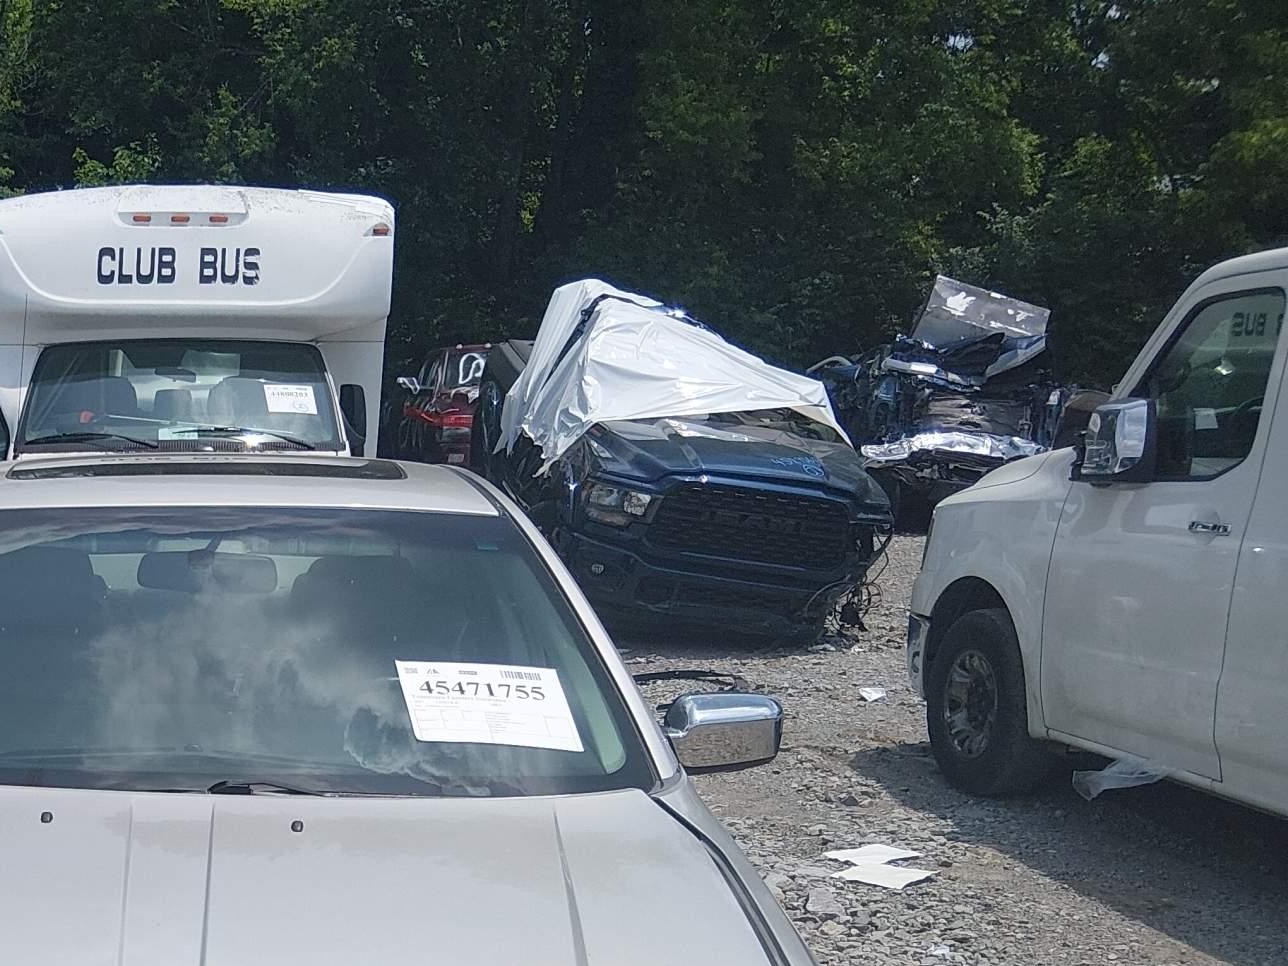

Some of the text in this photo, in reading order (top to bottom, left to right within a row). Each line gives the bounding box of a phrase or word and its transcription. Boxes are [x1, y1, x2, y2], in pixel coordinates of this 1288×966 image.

[97, 247, 261, 285] CLUB BUS
[419, 680, 546, 701] 45471755
